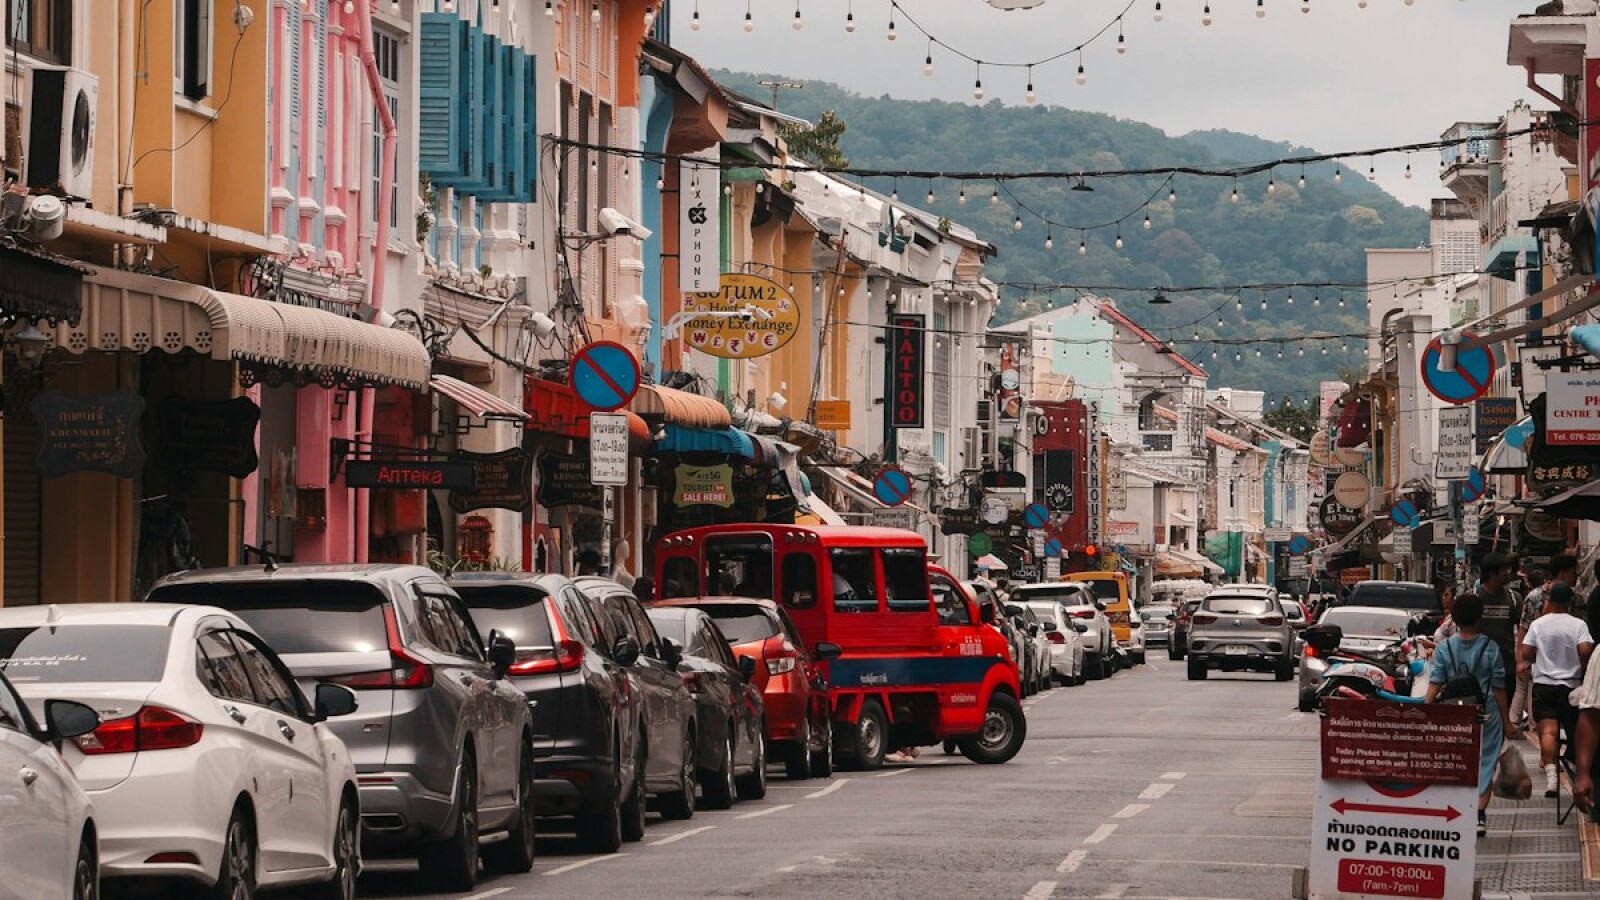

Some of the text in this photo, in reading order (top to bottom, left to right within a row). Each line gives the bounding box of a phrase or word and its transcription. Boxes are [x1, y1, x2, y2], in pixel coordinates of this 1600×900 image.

[767, 286, 776, 300] 2
[898, 322, 915, 422] TATTOO
[1553, 410, 1591, 418] CENTRE
[378, 466, 443, 484] Аптека
[1090, 401, 1098, 545] STEAKHOUSE
[683, 493, 701, 502] SALE
[1336, 747, 1355, 756] Today
[1357, 748, 1380, 757] Phuket
[1382, 749, 1408, 759] Walking
[1340, 757, 1365, 767] parking
[1377, 759, 1393, 767] both
[1327, 819, 1461, 842] ห้ามจอดตลอดแนว
[1326, 837, 1460, 860] NO PARKING
